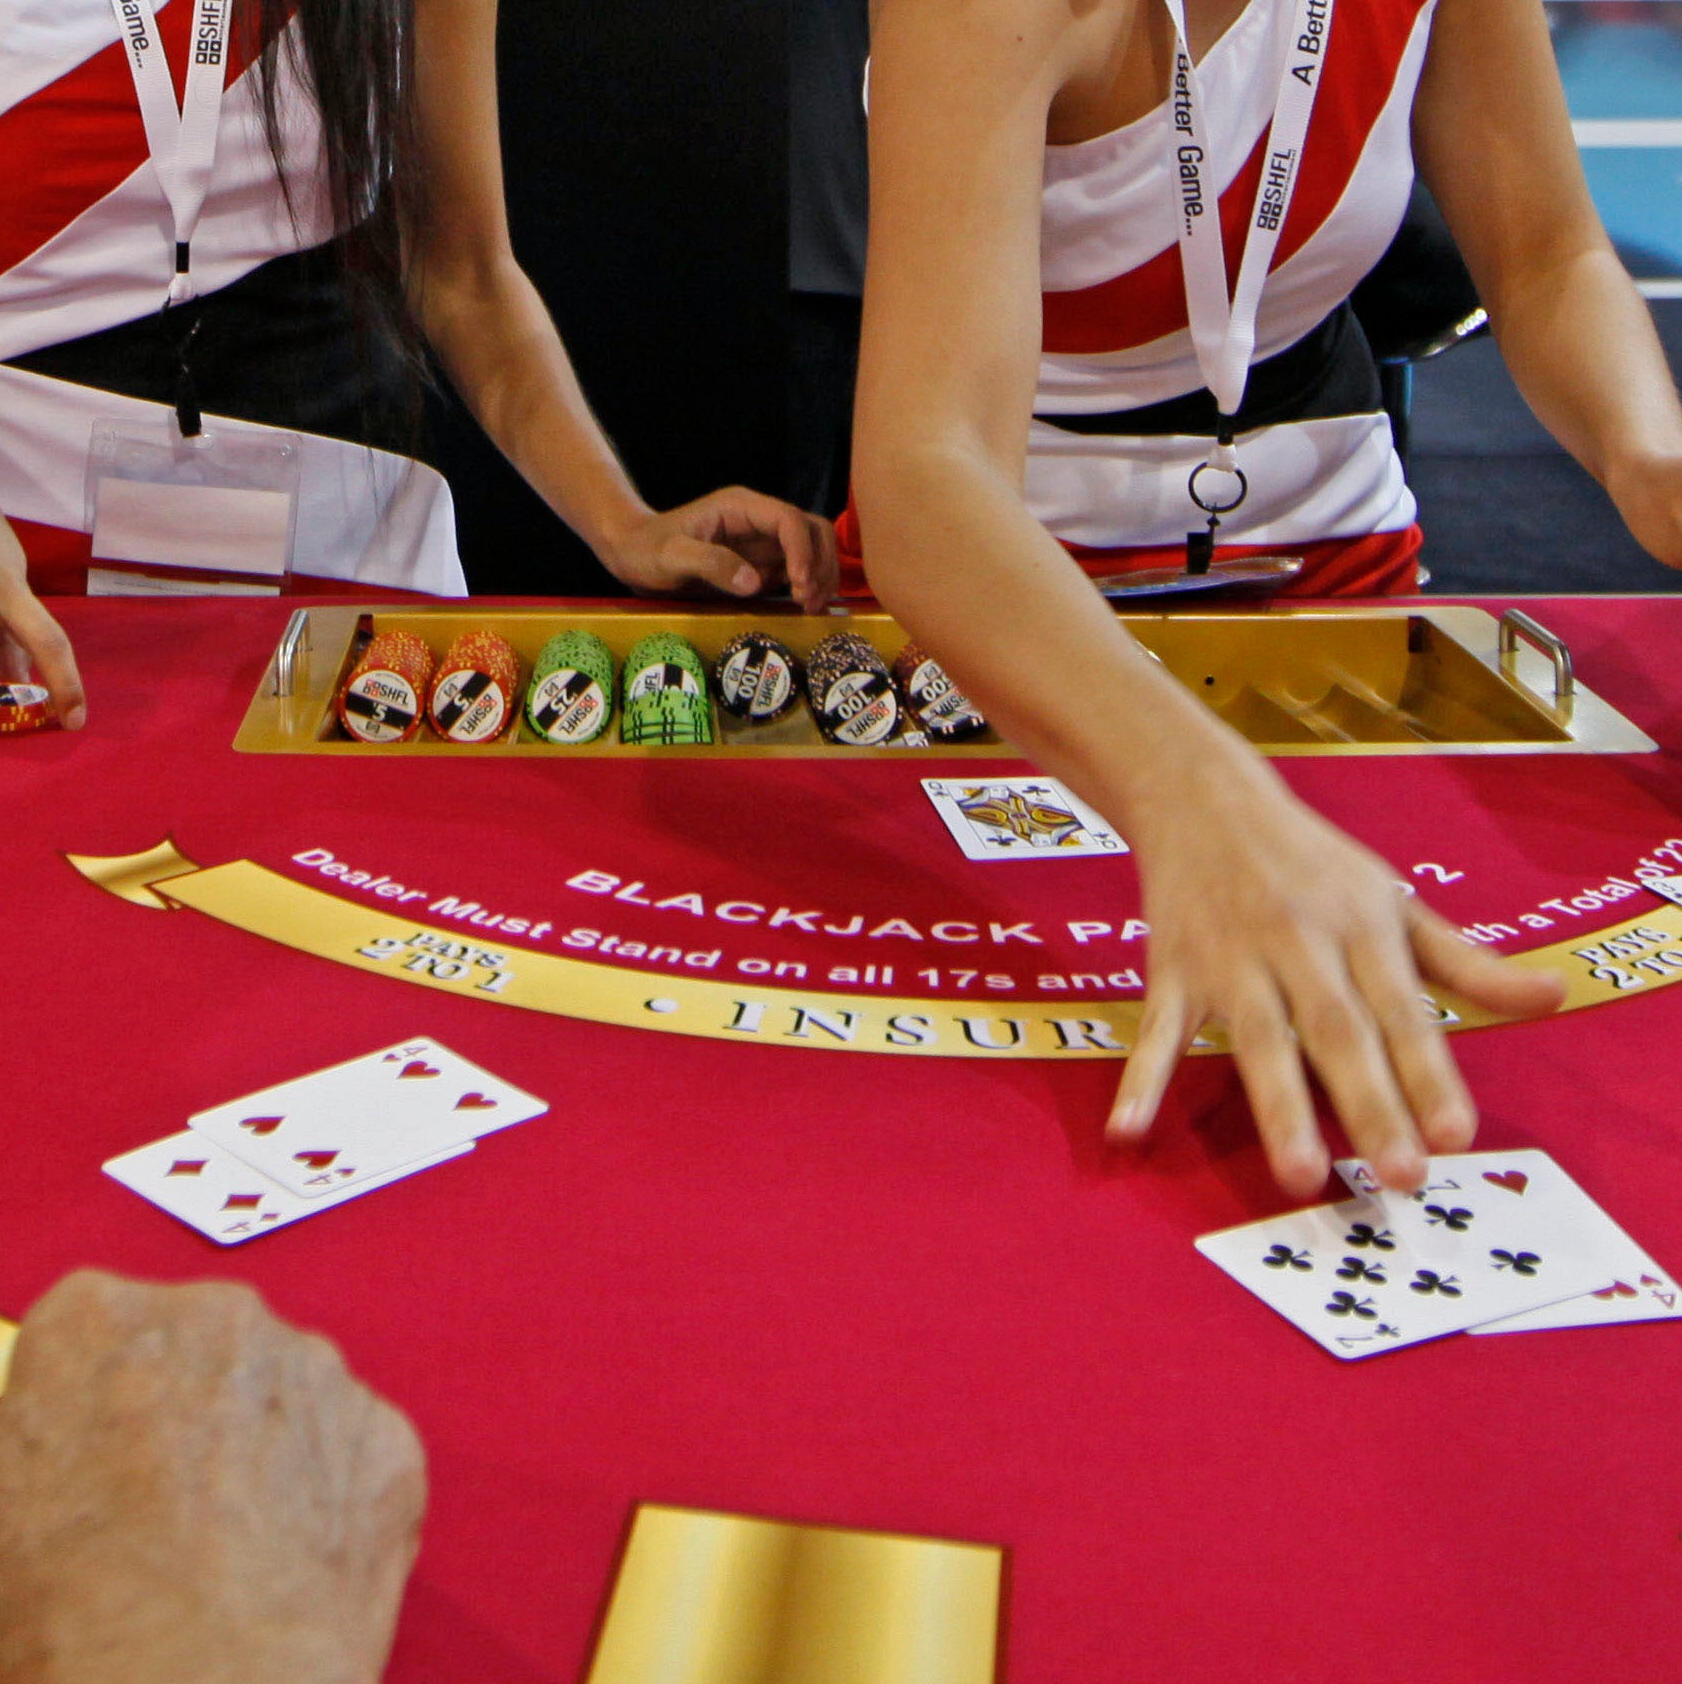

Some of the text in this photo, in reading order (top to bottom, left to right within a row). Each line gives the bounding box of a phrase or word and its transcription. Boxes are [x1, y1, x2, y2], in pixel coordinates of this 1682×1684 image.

[1291, 63, 1316, 86] A
[1176, 145, 1206, 237] Game...
[1265, 146, 1294, 202] SHFL
[379, 684, 409, 705] SHFL
[291, 847, 429, 904] Dealer
[428, 895, 554, 940] Must
[561, 928, 723, 968] Stand
[737, 958, 809, 979] on
[828, 964, 894, 985] all
[917, 968, 1016, 990] 17s
[1036, 968, 1144, 990] and
[1517, 913, 1556, 930] a
[1538, 876, 1643, 919] Total
[1634, 857, 1675, 882] of
[565, 869, 1044, 944] BLACKJACK
[1411, 862, 1465, 886] 2
[355, 937, 516, 994] 2 TO 1
[404, 932, 510, 969] PAYS
[1570, 926, 1673, 965] PAYS
[1589, 967, 1646, 991] 2
